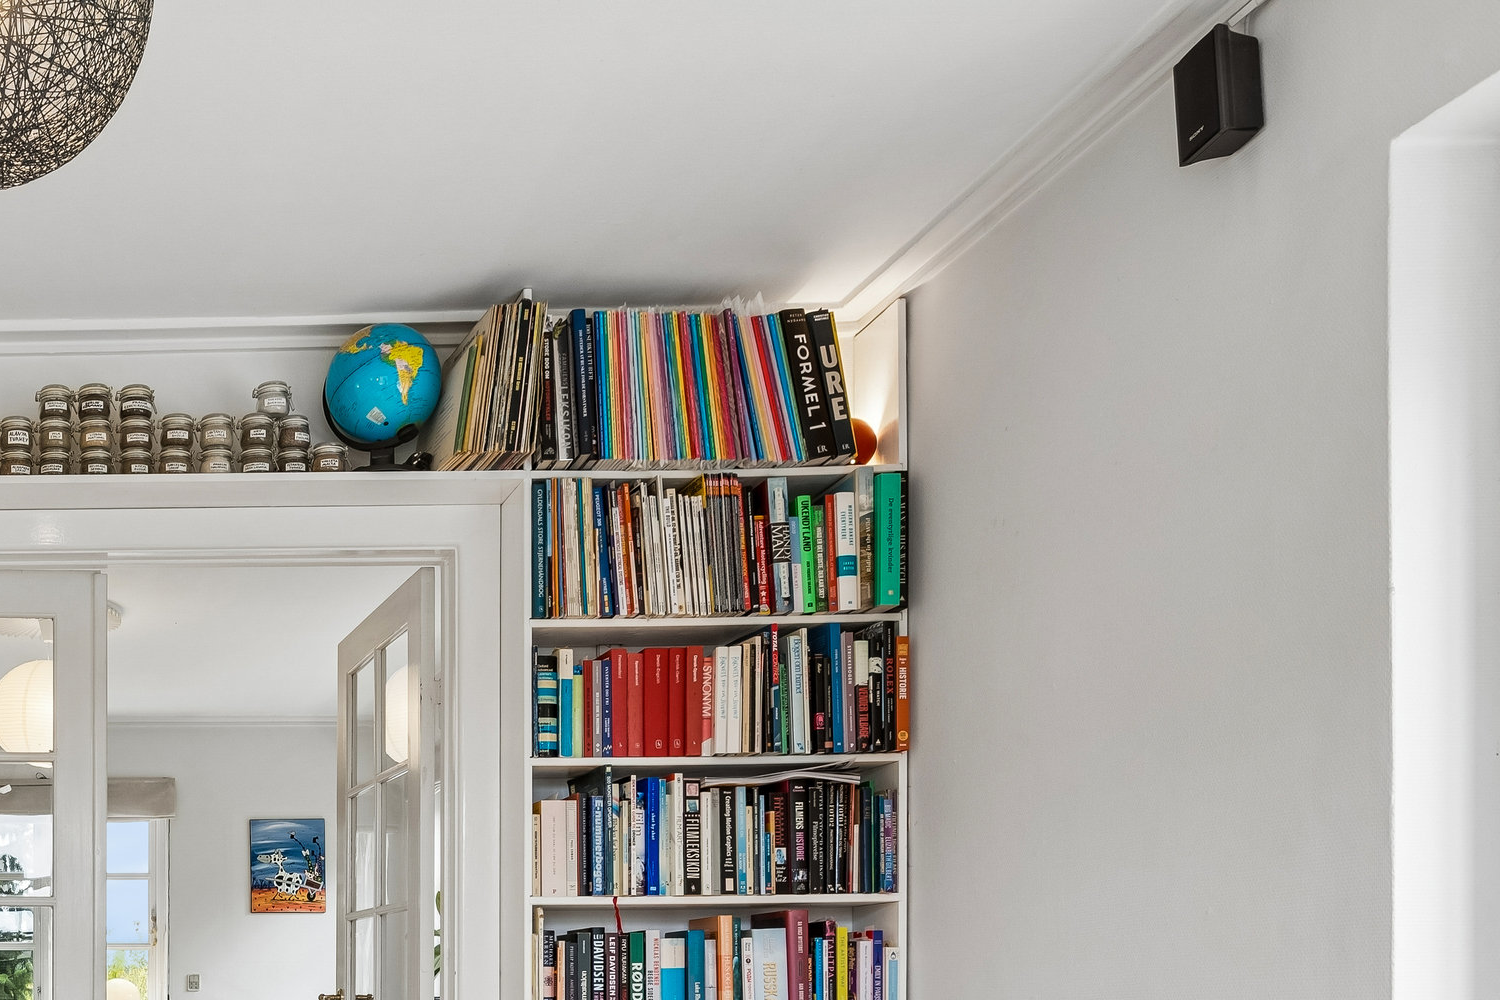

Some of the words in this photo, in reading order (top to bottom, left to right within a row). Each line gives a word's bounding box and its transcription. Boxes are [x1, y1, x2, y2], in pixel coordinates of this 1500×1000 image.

[545, 370, 550, 379] OM
[793, 333, 820, 417] FORMEL
[809, 421, 827, 430] 1
[819, 344, 847, 421] URE
[560, 386, 571, 449] LEKSIKON
[801, 500, 811, 530] UKENDT
[888, 498, 894, 507] De
[771, 525, 784, 560] MAN
[783, 525, 792, 560] HANDY
[803, 532, 811, 552] LAND
[887, 508, 895, 546] eventyrlige
[759, 549, 767, 584] Motorcycling
[792, 639, 803, 659] Bogen
[794, 661, 801, 672] om
[886, 658, 894, 694] ROLEX
[702, 665, 712, 717] SYNONYM
[899, 667, 907, 699] HISTORIE
[859, 687, 868, 711] VENDER
[859, 714, 869, 738] TILBAGE
[724, 795, 732, 817] Creating
[795, 802, 804, 830] FILMENS
[636, 812, 644, 836] Film
[593, 800, 603, 892] E-nummerbogen
[686, 818, 700, 879] FILMLEKSIKON
[725, 836, 733, 857] Graphics
[796, 832, 804, 861] HISTORIE
[593, 940, 604, 991] DAVIDSEN
